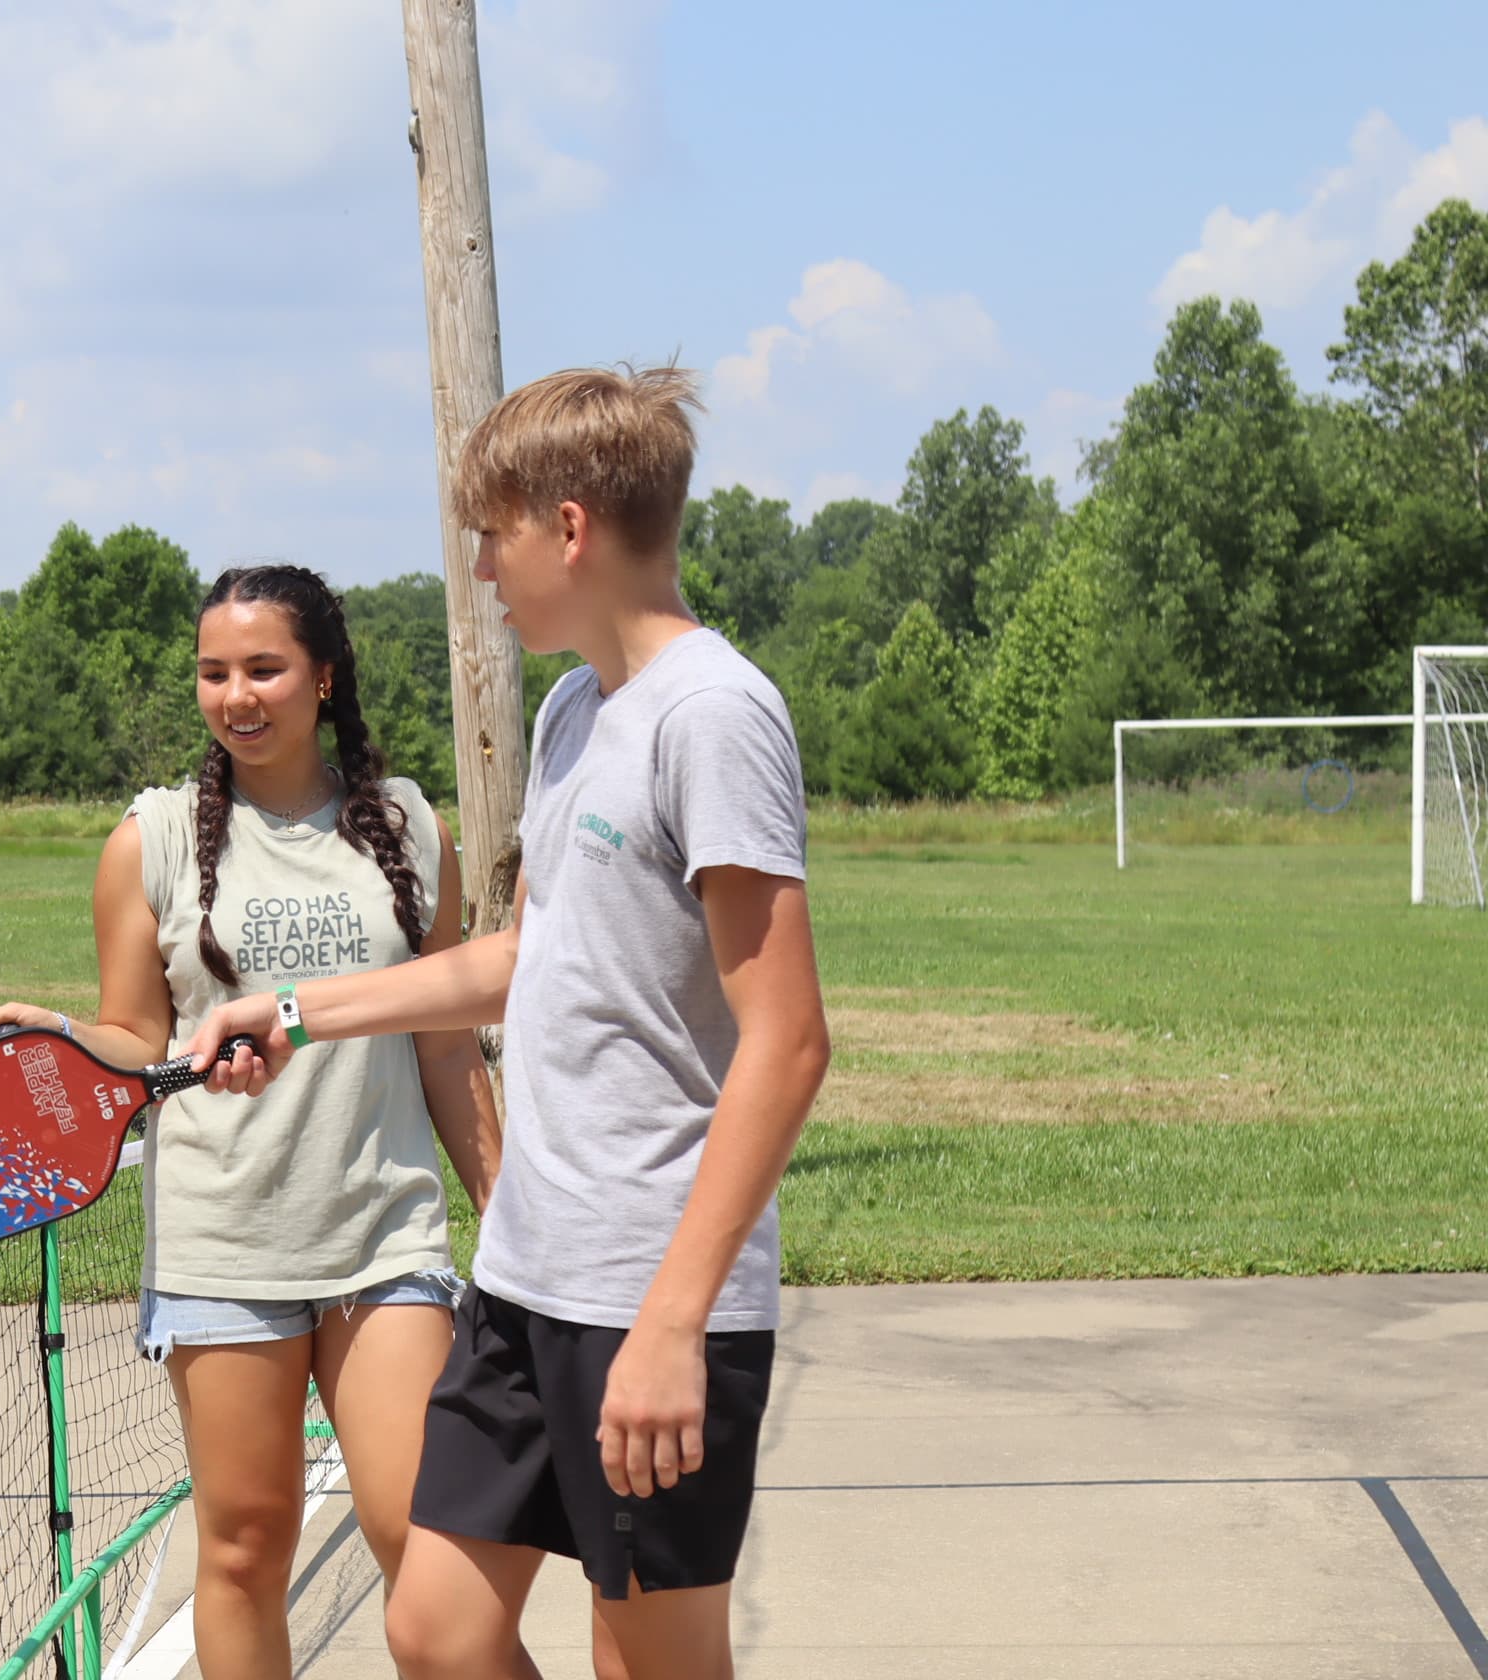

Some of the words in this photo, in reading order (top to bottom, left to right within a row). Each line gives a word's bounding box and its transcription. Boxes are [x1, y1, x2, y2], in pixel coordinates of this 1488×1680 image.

[245, 898, 301, 919] GOD
[307, 892, 351, 915] HAS
[241, 920, 280, 946] SET
[286, 918, 303, 942] A
[307, 913, 363, 940] PATH
[236, 942, 331, 974] BEFORE
[336, 937, 371, 967] ME
[17, 1047, 54, 1116] HYPER
[34, 1042, 79, 1135] FEATHER
